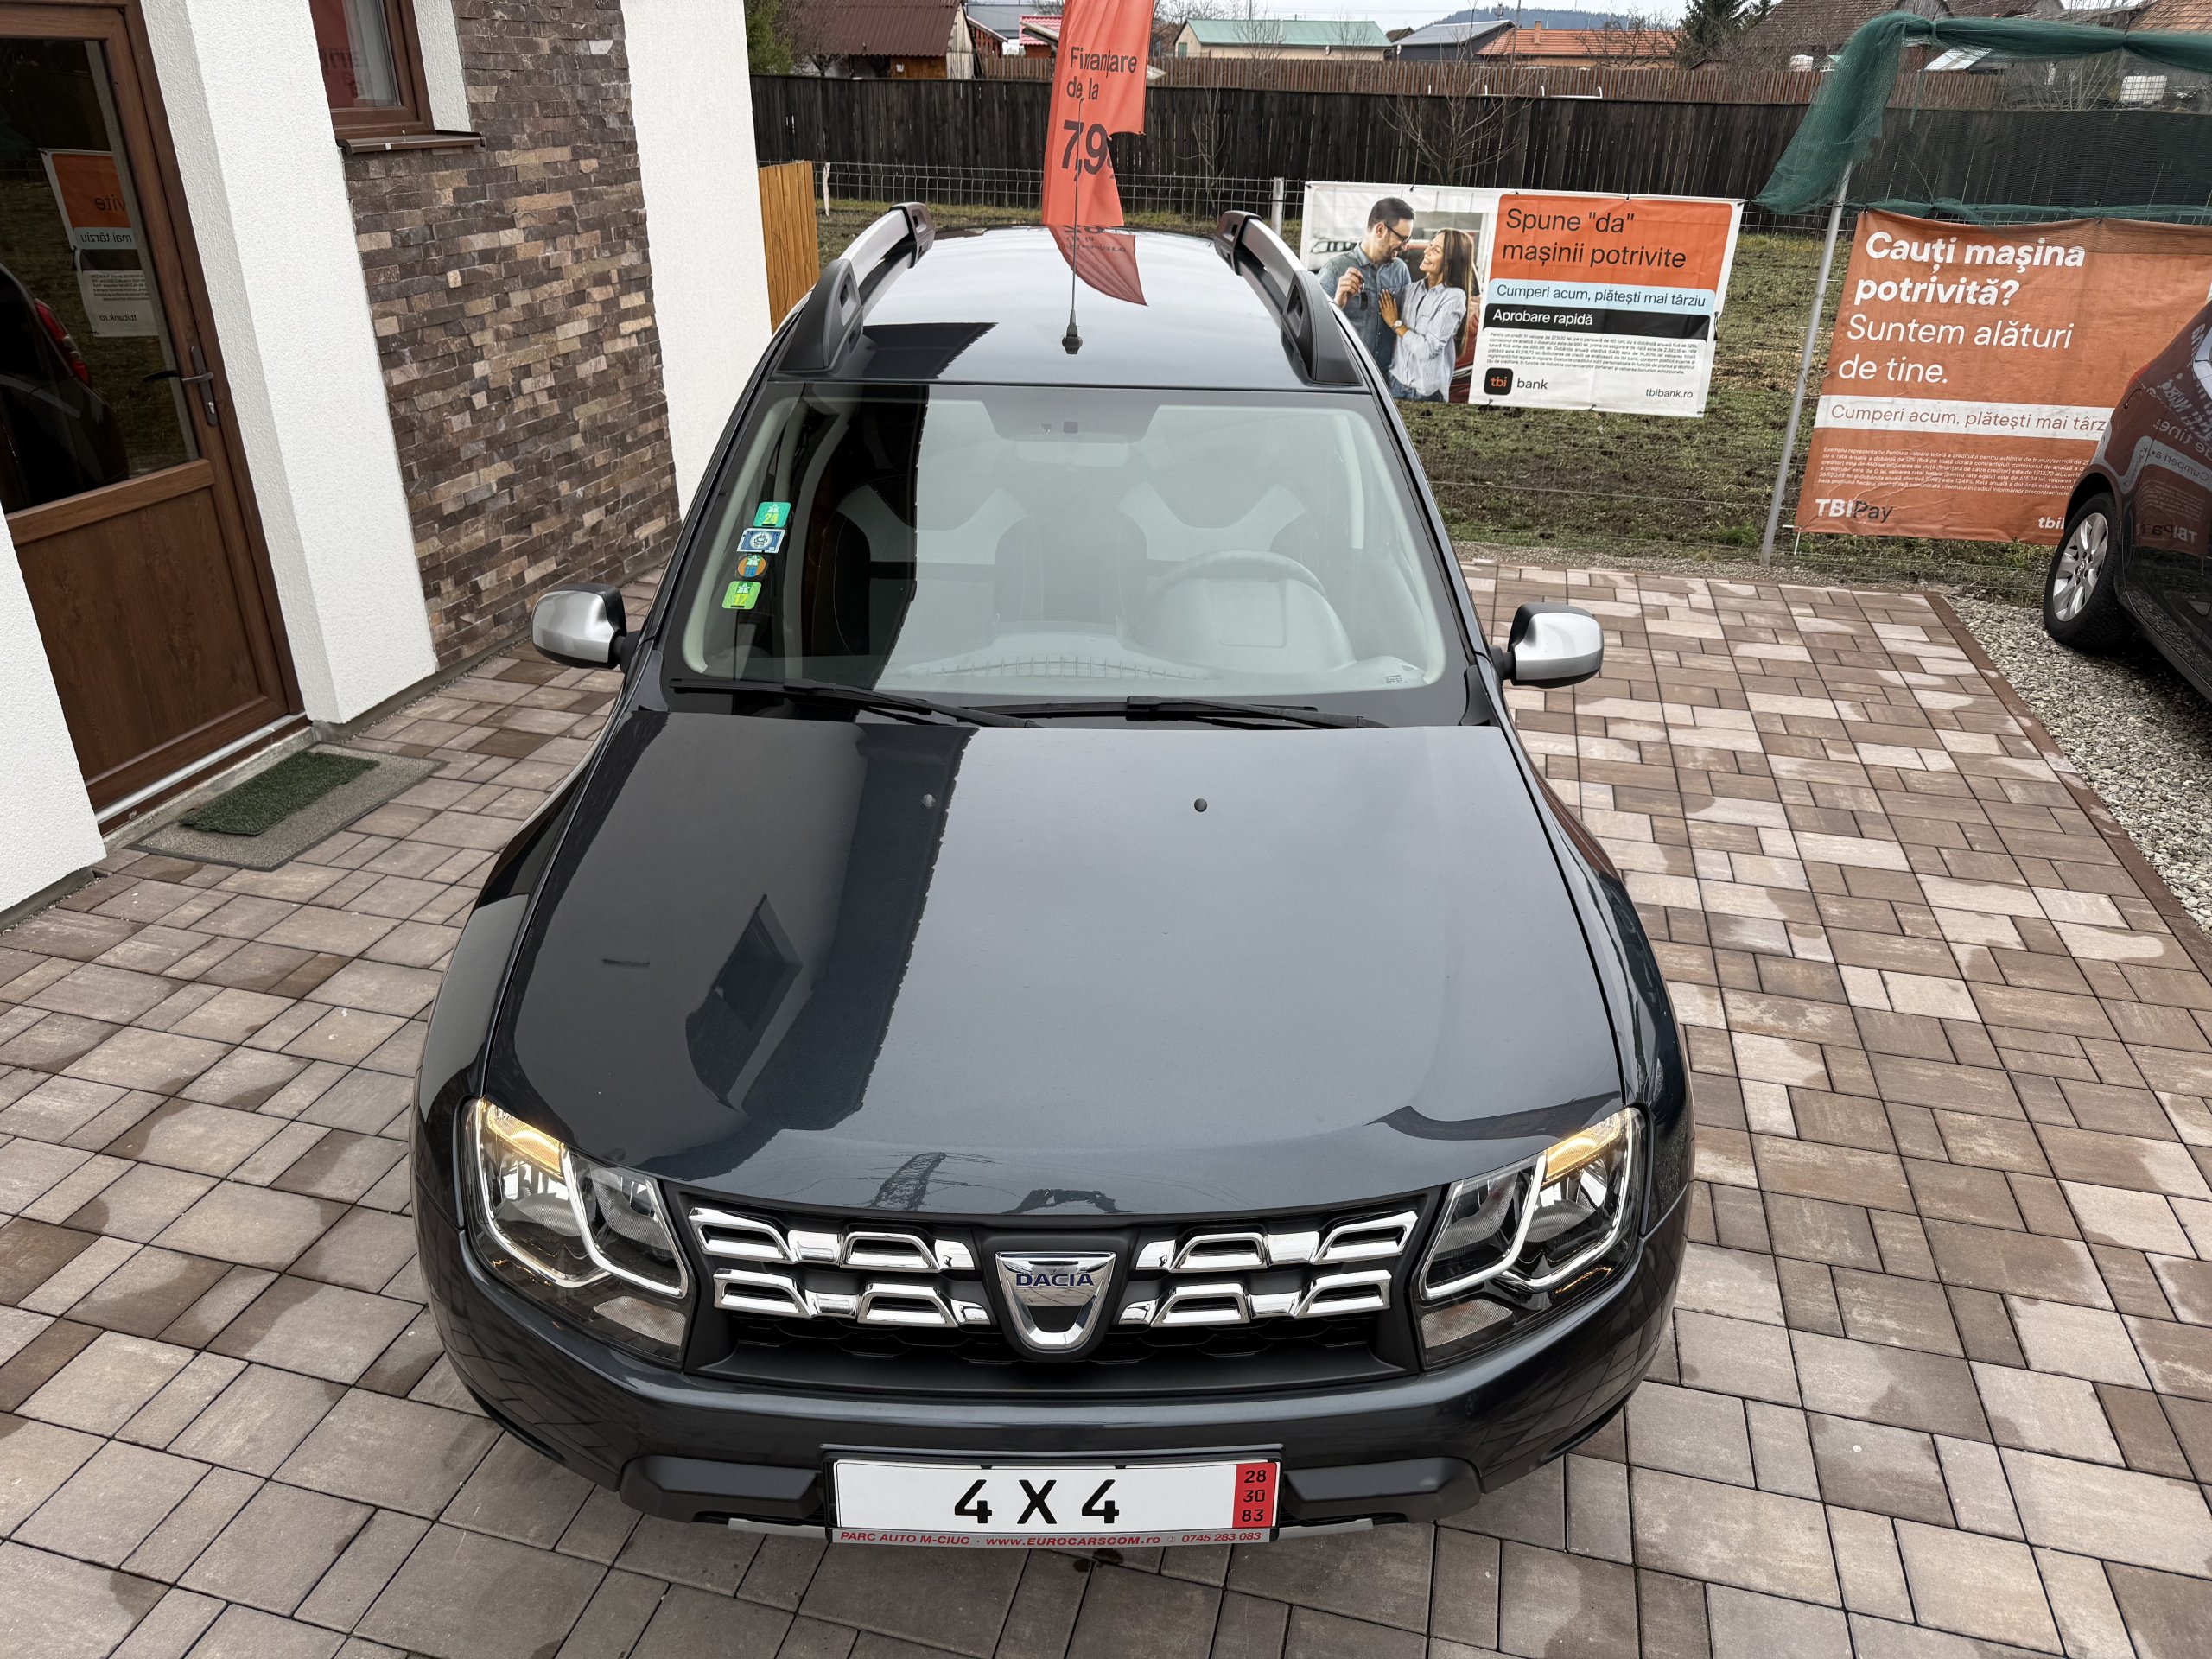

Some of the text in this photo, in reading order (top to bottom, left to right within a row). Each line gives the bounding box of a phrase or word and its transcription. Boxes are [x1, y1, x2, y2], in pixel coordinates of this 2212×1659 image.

[1067, 76, 1099, 100] de la
[1506, 208, 1634, 233] Spune "da"
[1503, 242, 1686, 267] mașinii potrivite
[1866, 231, 1957, 273] Cauți
[1497, 284, 1706, 307] Cumperi acum, plătești mai târziu
[1854, 276, 2019, 306] potrivită?
[1492, 309, 1592, 327] Aprobare rapidă
[1847, 314, 2075, 348] Suntem alături
[1839, 353, 1948, 383] de tine.
[1491, 376, 1694, 399] tbi bank tbibank.ro
[1831, 404, 1904, 422] Cumperi
[1909, 411, 1959, 425] acum,
[2035, 416, 2066, 429] mai
[2073, 416, 2107, 432] târz
[1815, 499, 1895, 524] TBIPay
[1015, 1273, 1094, 1287] DACIA
[1244, 1470, 1267, 1483] 28
[954, 1479, 1120, 1525] 4 X 4
[1243, 1489, 1265, 1503] 30
[1241, 1509, 1264, 1522] 83
[841, 1532, 1262, 1547] PARC AUTO M-CIUC www.EUROCARSCOM.ro 0745 283 083
